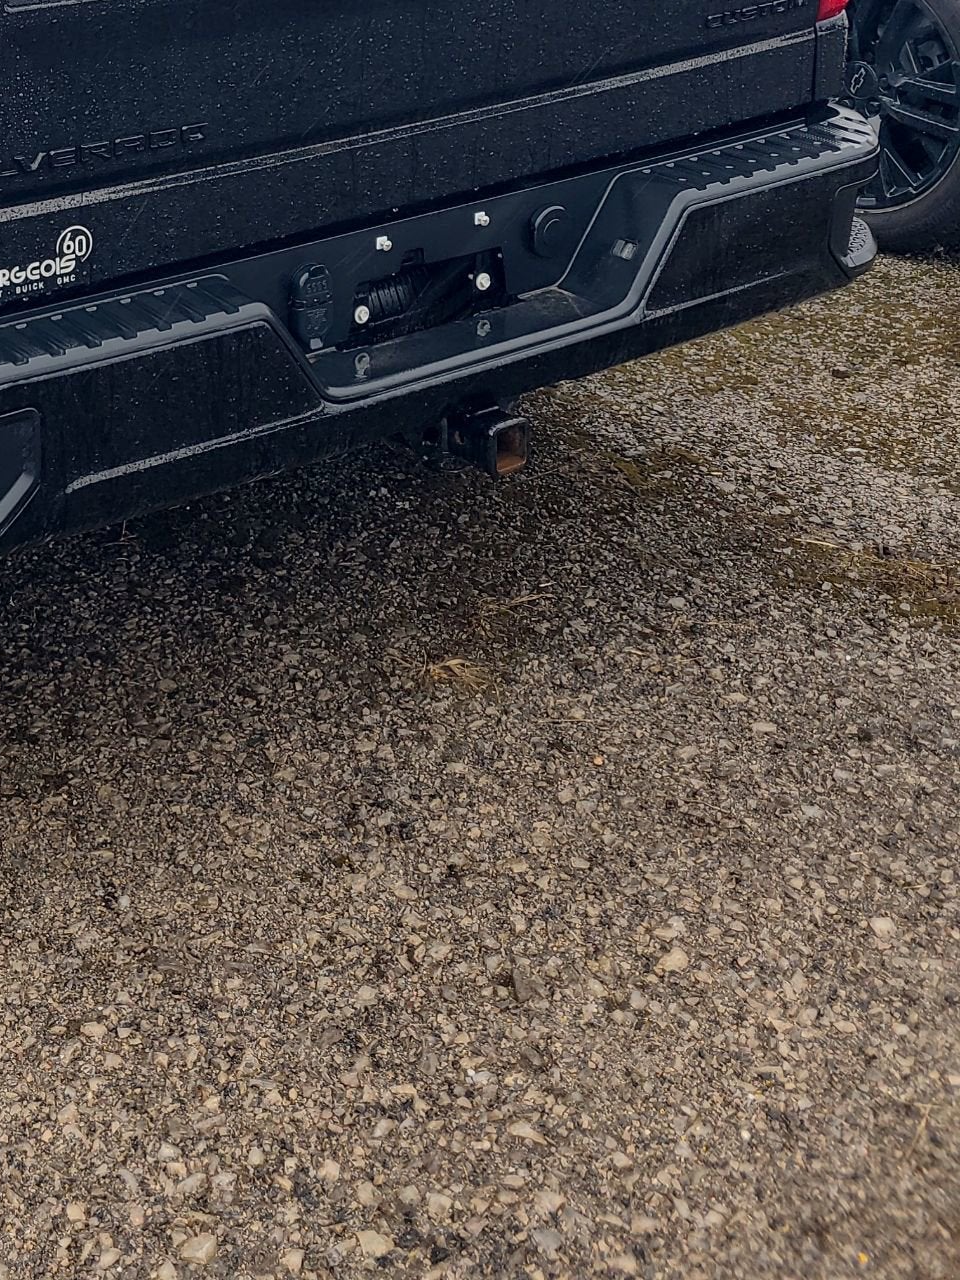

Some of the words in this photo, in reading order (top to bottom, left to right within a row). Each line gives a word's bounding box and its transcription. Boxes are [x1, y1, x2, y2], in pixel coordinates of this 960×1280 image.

[62, 231, 88, 257] 60
[15, 281, 46, 295] BUICK
[56, 274, 77, 286] GMC
